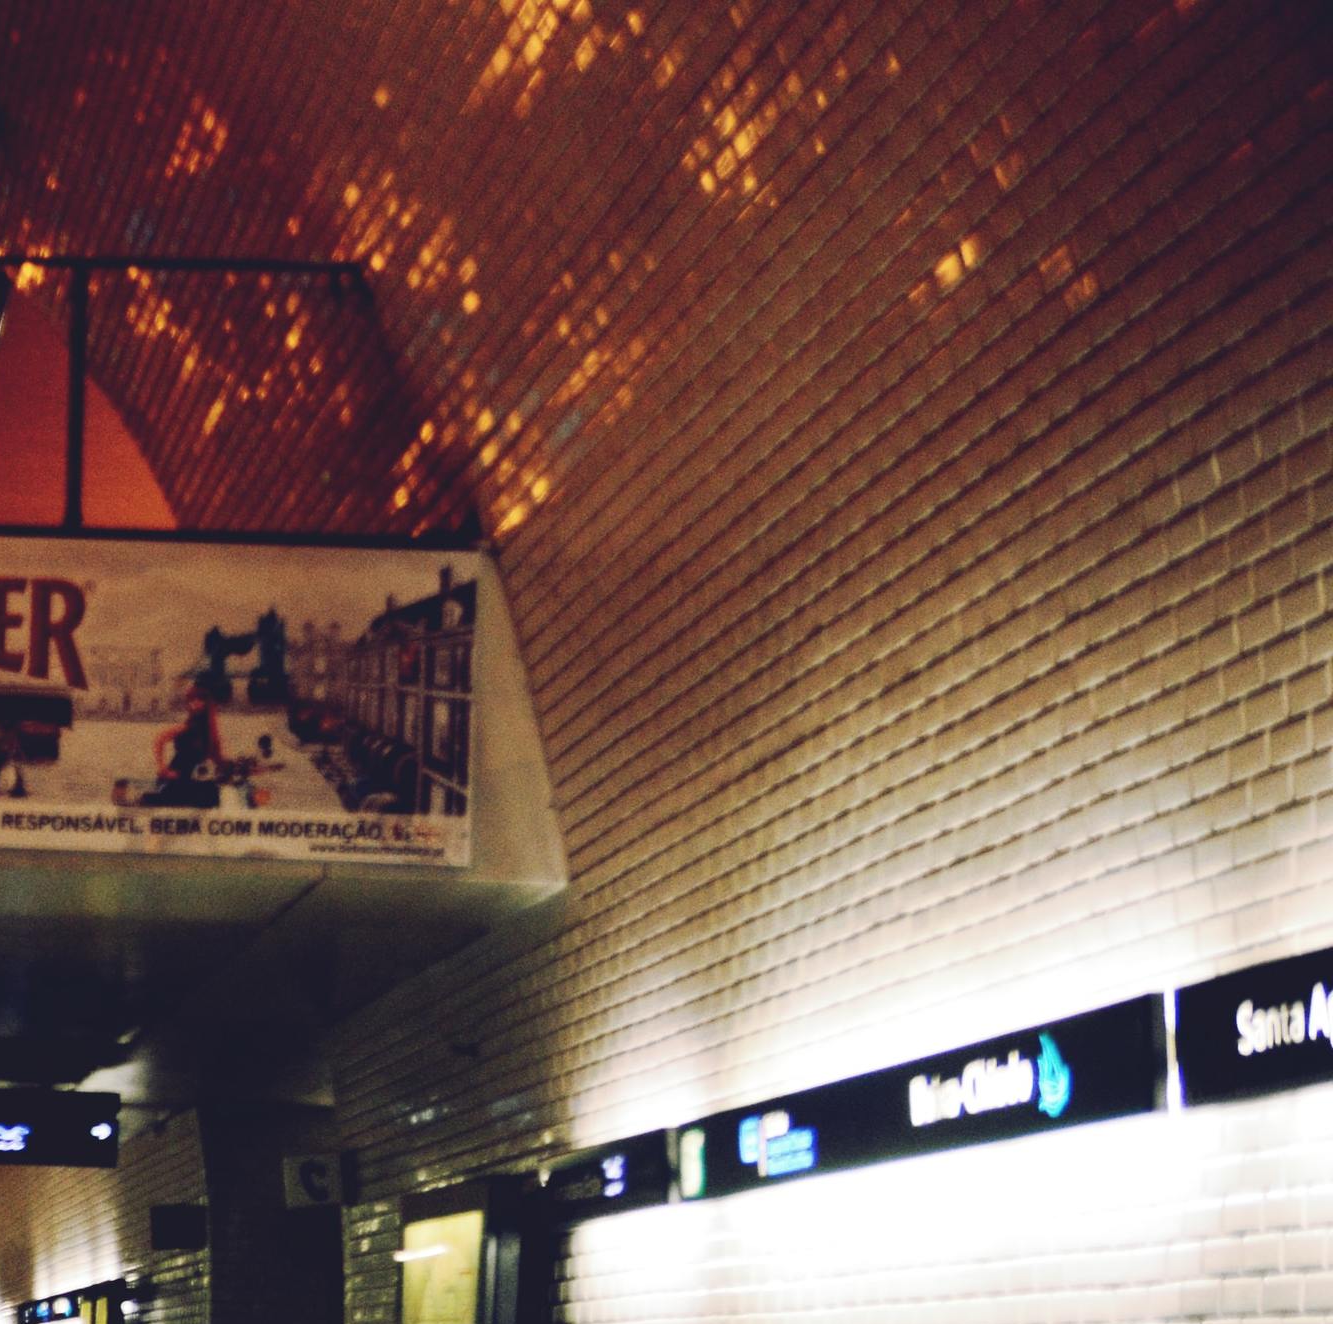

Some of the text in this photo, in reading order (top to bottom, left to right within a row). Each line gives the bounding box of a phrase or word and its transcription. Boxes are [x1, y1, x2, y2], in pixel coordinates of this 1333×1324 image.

[150, 818, 202, 836] BEBA
[208, 819, 252, 837] COM
[1236, 998, 1306, 1056] Santa
